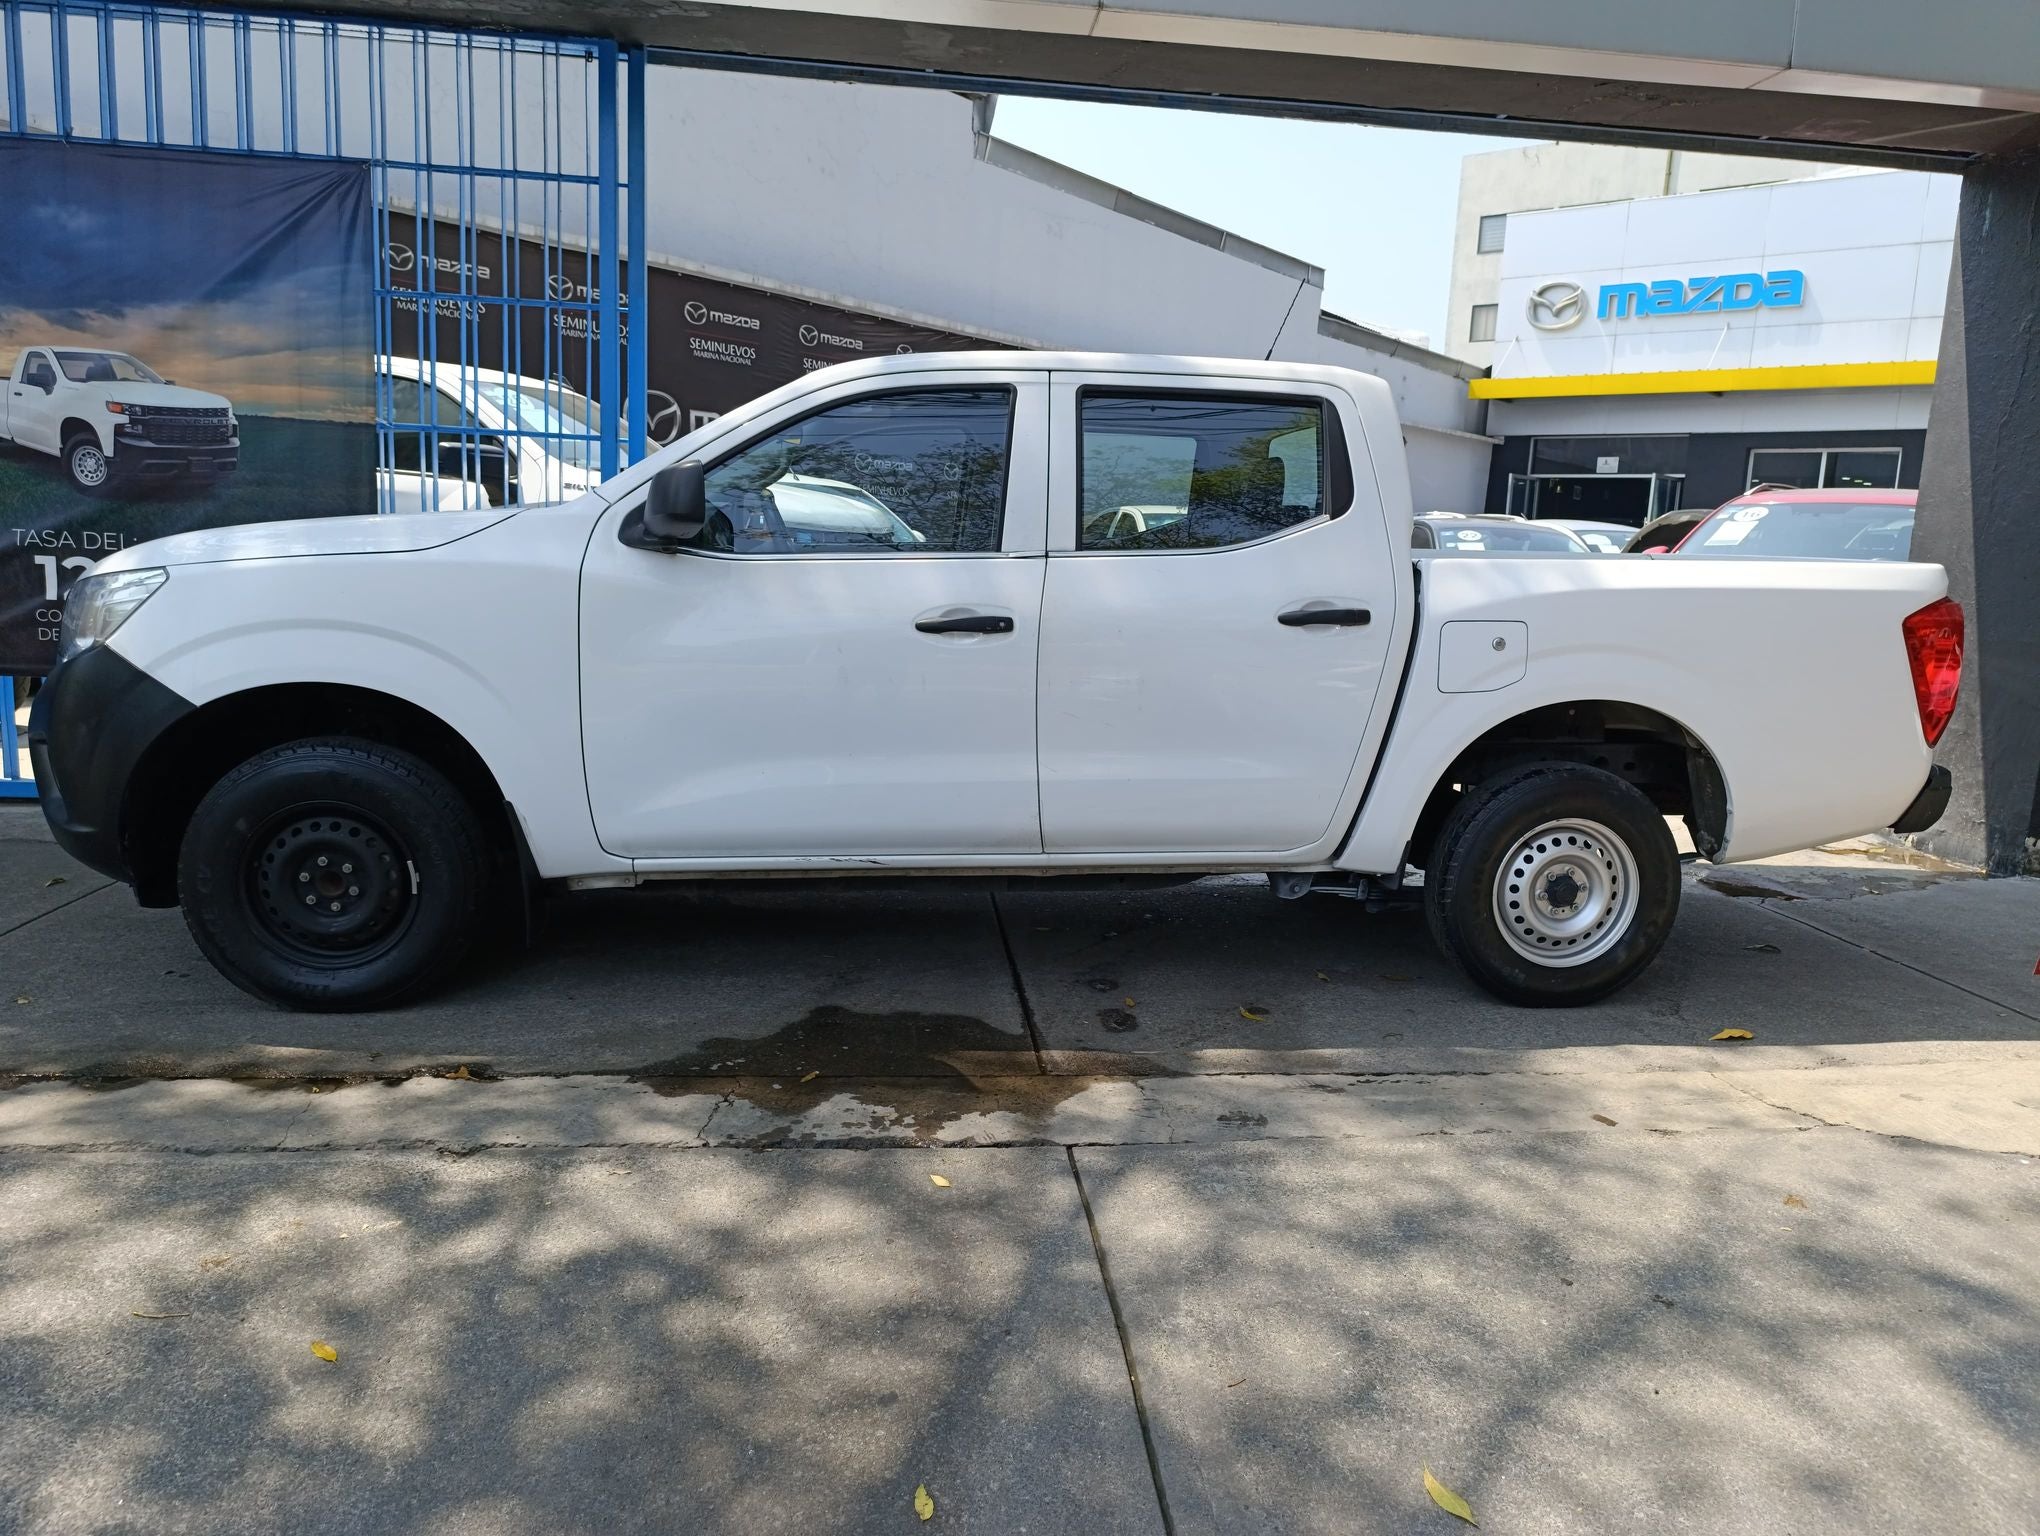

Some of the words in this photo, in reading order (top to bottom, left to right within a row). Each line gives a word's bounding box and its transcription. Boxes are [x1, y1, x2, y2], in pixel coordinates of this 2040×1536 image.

[576, 285, 629, 304] mad
[1597, 270, 1804, 320] mazda
[709, 310, 760, 330] mazda
[689, 337, 757, 359] SEMINUEVOS
[820, 333, 863, 350] mazda
[693, 350, 720, 360] MARINA
[720, 354, 752, 366] NACIONAL
[803, 357, 834, 370] SEMIN
[12, 528, 77, 549] TASA
